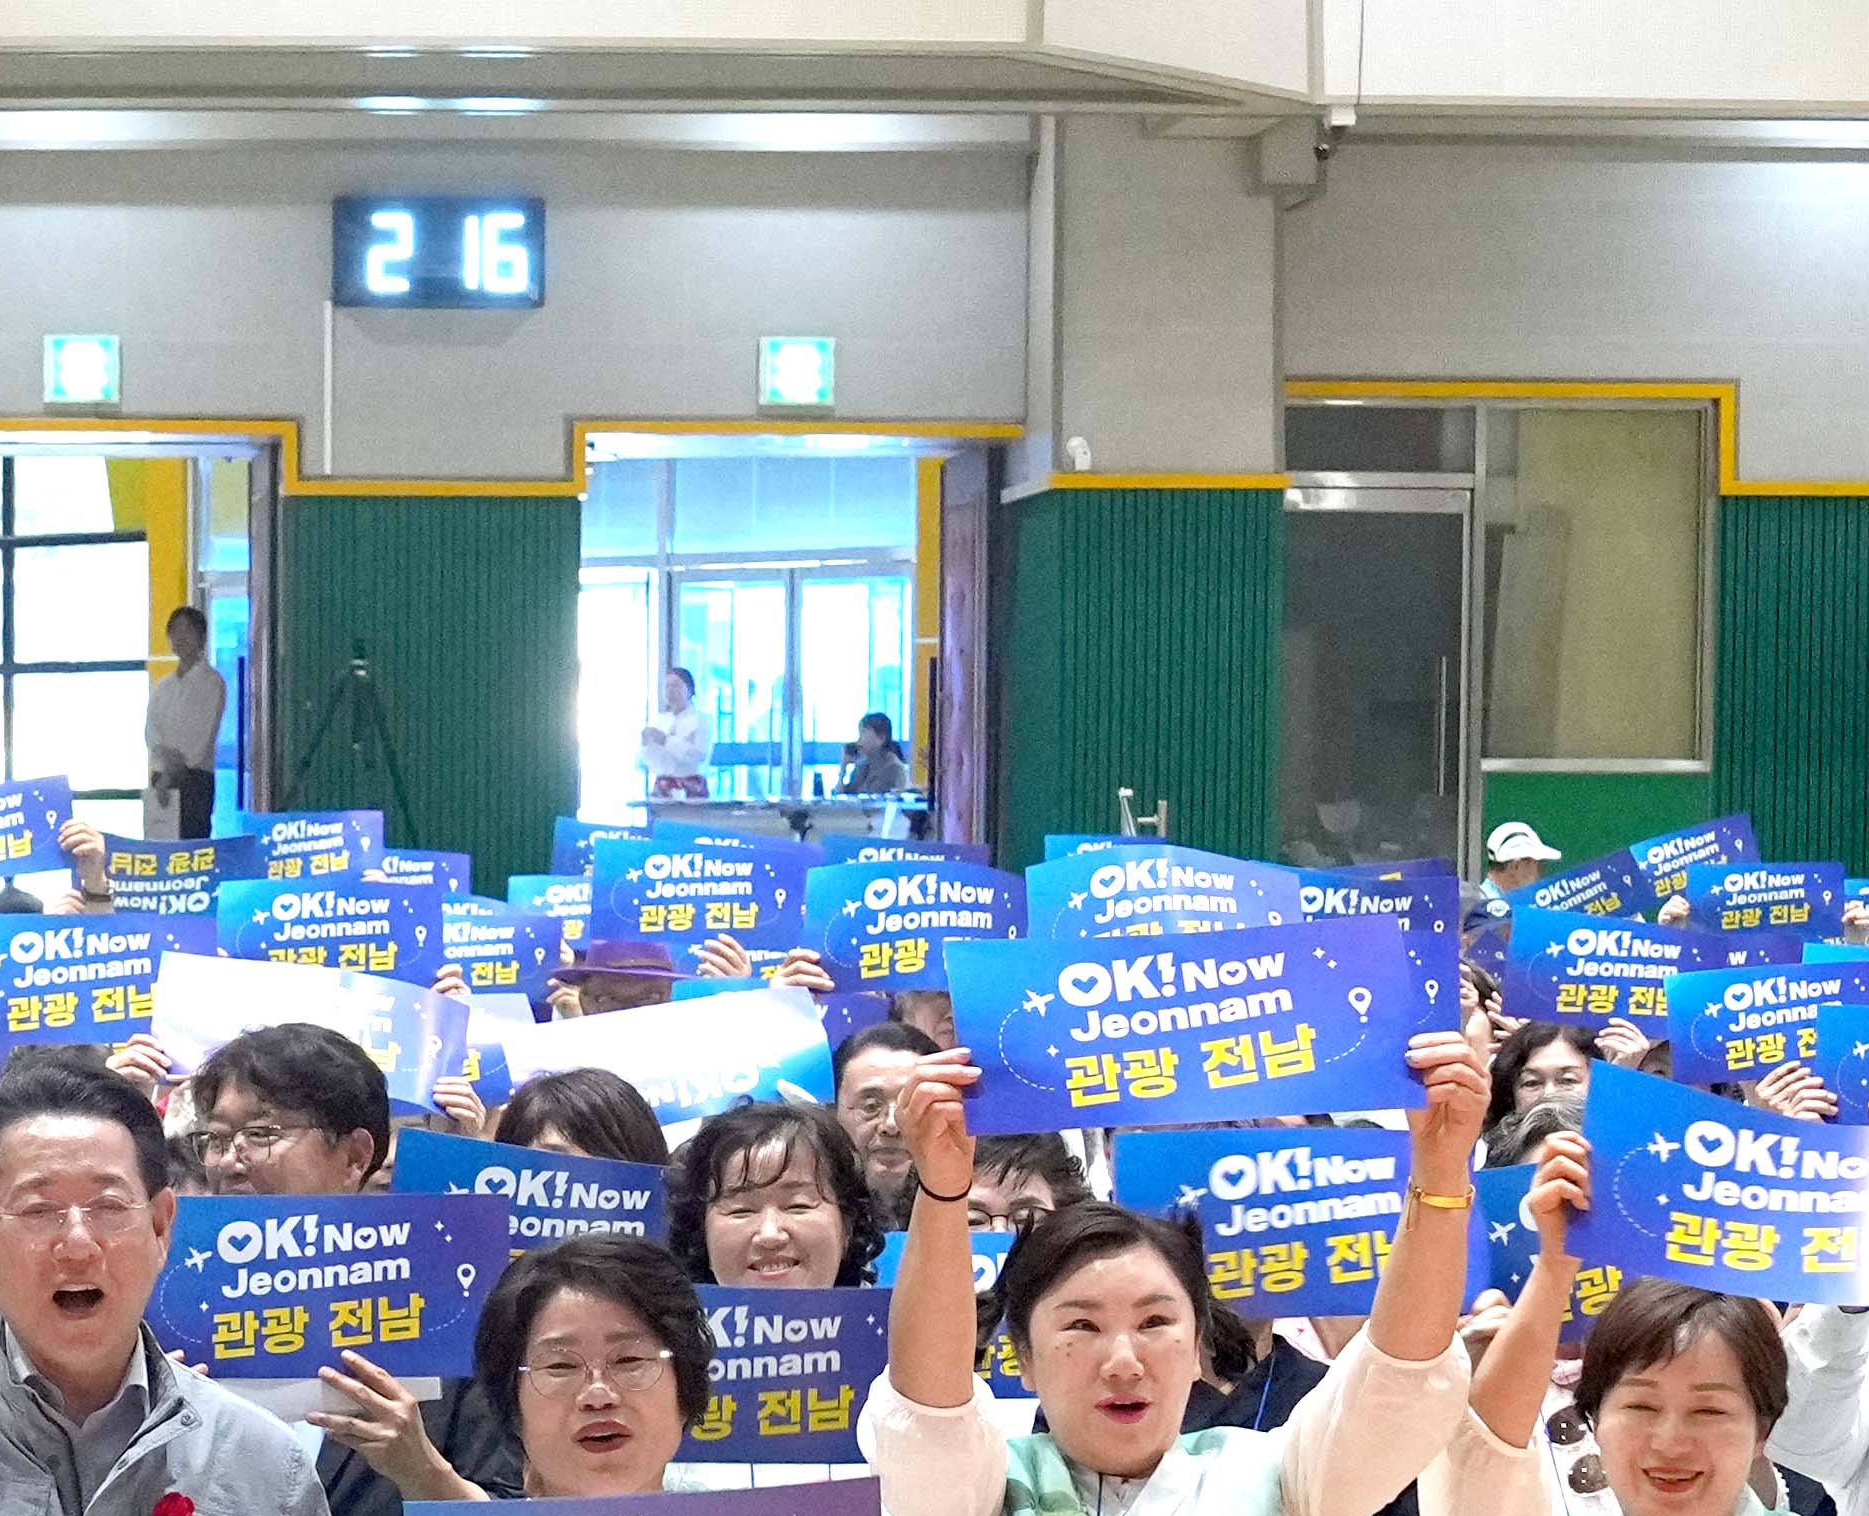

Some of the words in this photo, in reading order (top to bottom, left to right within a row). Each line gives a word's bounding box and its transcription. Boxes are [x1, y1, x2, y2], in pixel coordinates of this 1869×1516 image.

[366, 212, 414, 293] 2
[464, 212, 529, 293] 16
[645, 853, 702, 879] OK!
[704, 860, 753, 876] Now
[1724, 871, 1767, 892] OK!
[1768, 874, 1804, 887] Now
[646, 881, 752, 898] Jeonnam
[1726, 888, 1805, 906] Jeonnam
[640, 904, 695, 932] 관광
[706, 903, 758, 928] 전남
[1722, 908, 1761, 929] 관광
[1771, 904, 1810, 924] 전남
[1059, 953, 1176, 1006] OK!
[1182, 953, 1284, 992] Now
[1070, 989, 1293, 1041] Jeonnam
[1066, 1048, 1178, 1107] 관광
[1201, 1024, 1316, 1088] 전남
[217, 1215, 318, 1263] OK!
[324, 1223, 410, 1253] Now
[222, 1258, 410, 1298] Jeonnam
[213, 1306, 309, 1359] 관광
[329, 1293, 425, 1347] 전남
